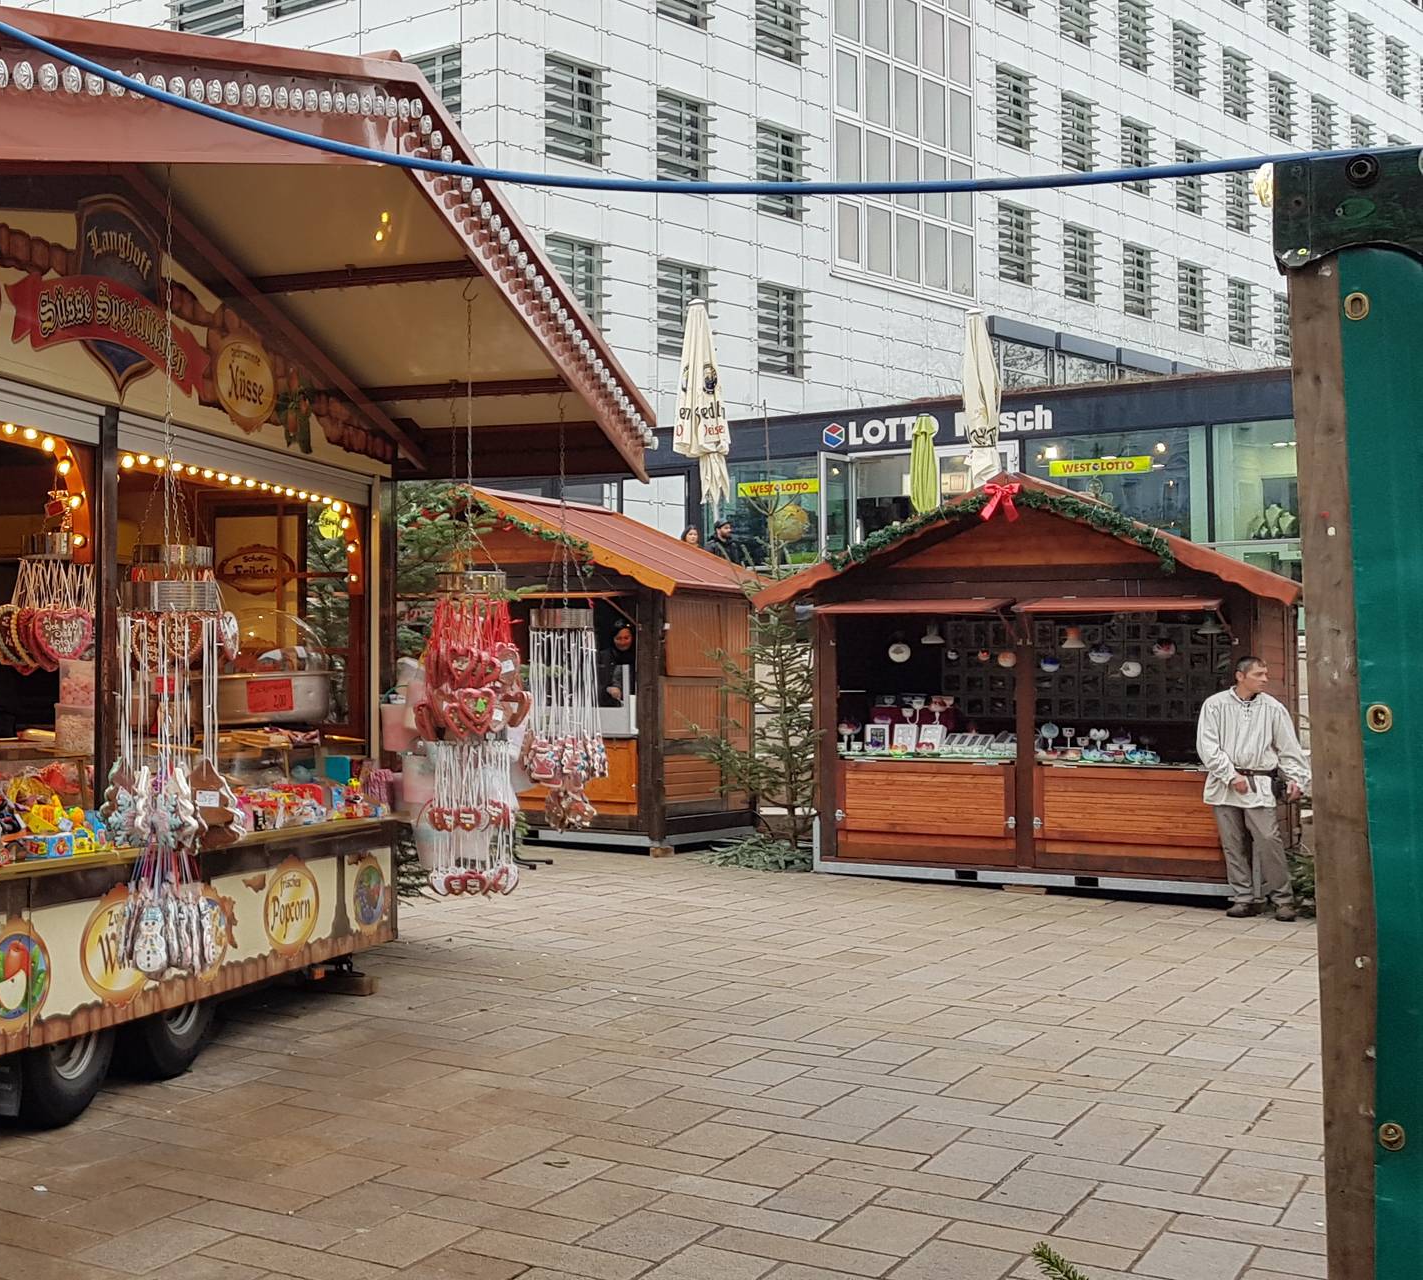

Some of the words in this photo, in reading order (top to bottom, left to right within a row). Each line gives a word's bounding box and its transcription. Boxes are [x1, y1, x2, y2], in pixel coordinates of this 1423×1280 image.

[86, 225, 153, 281] Langhoff
[38, 284, 94, 338] Süsse
[228, 363, 265, 406] Nüsse
[749, 484, 774, 494] WEST
[781, 482, 809, 492] LOTTO
[1062, 462, 1091, 474] WEST
[1100, 460, 1135, 471] LOTTO
[270, 895, 311, 939] Popcorn
